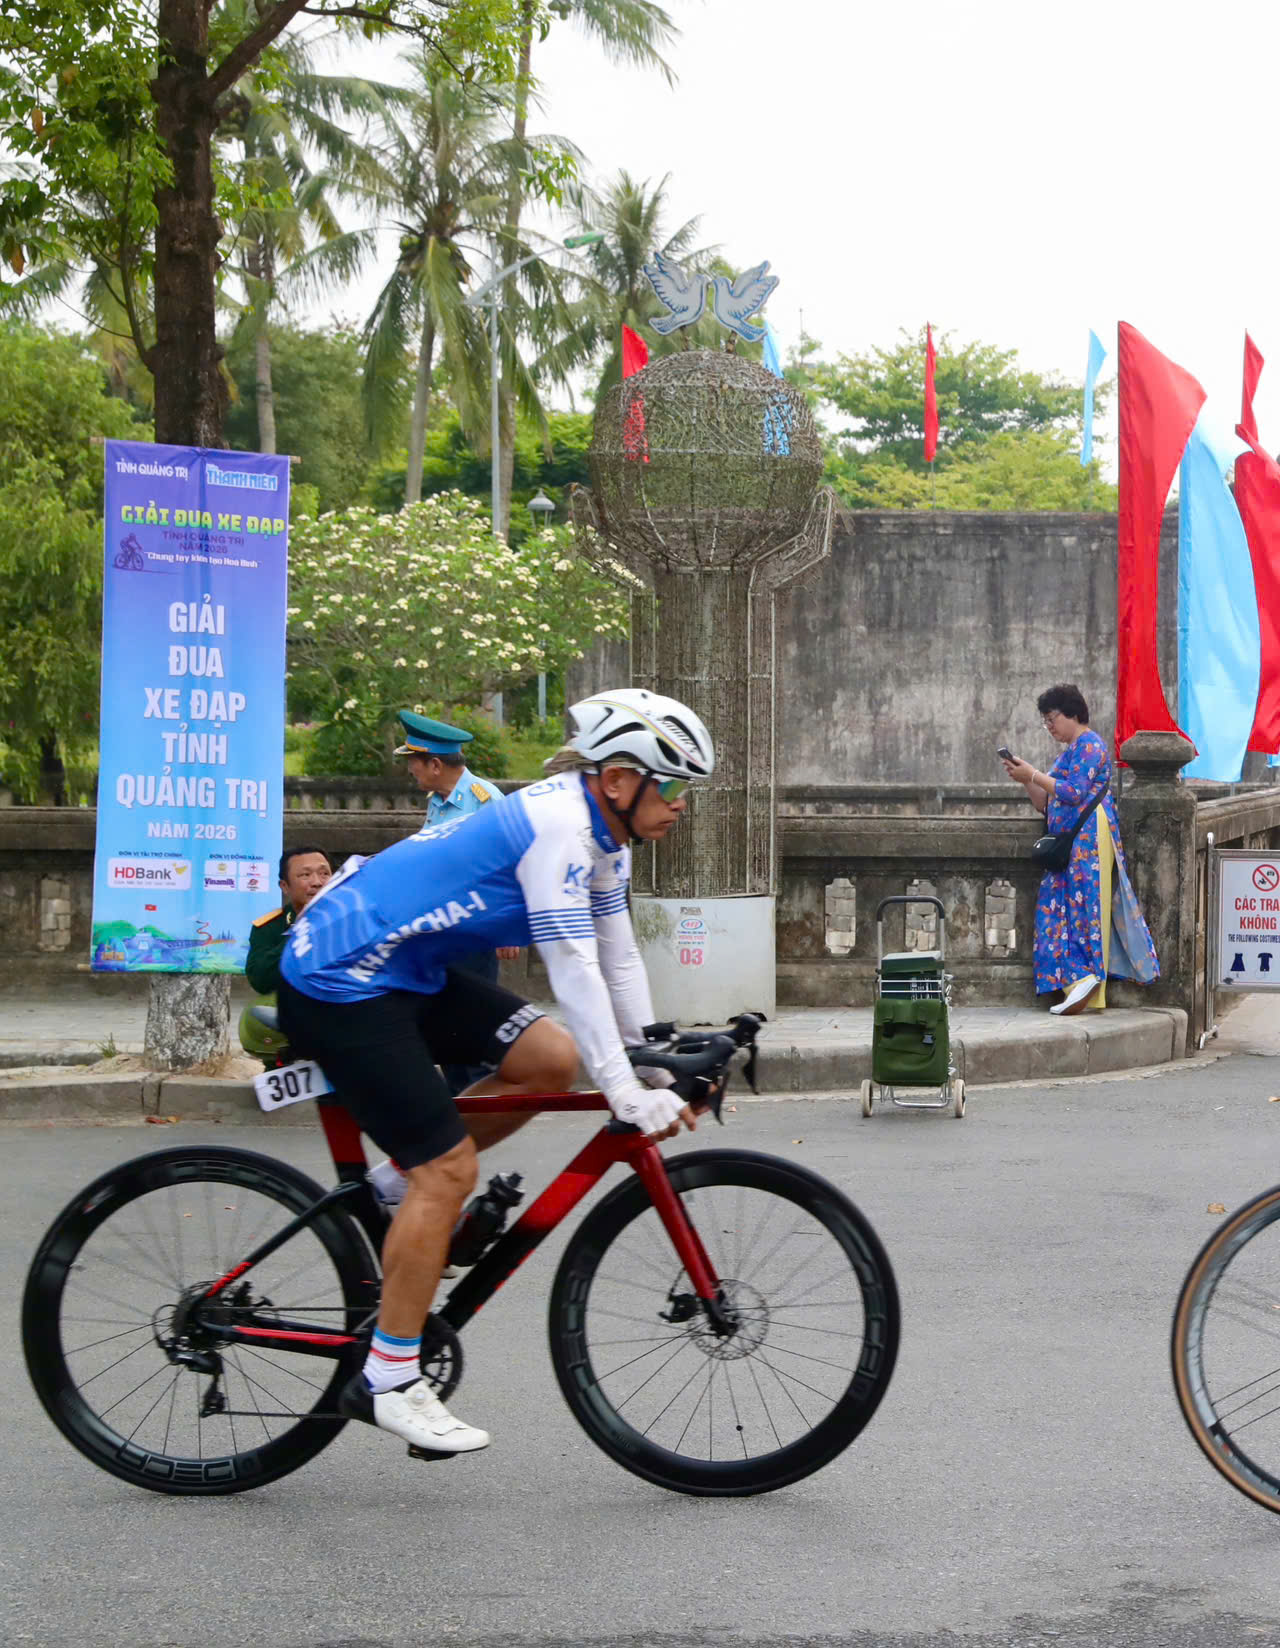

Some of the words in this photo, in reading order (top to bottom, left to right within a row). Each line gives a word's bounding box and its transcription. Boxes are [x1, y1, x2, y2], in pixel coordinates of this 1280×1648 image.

[121, 500, 170, 526] GIẢI
[174, 509, 213, 530] ĐUA
[218, 513, 242, 533] XE
[246, 515, 286, 540] ĐẠP
[169, 593, 225, 636] GIẢI
[168, 645, 225, 678] ĐUA
[144, 686, 181, 720] XE
[190, 689, 246, 728] ĐẠP
[161, 723, 229, 765] TỈNH
[116, 765, 216, 809] QUẢNG
[225, 778, 268, 818] TRỊ
[147, 819, 189, 840] NĂM
[195, 823, 238, 841] 2026
[114, 867, 172, 881] HDBank
[204, 877, 235, 888] Vinamilk
[1234, 895, 1257, 911] CÁC
[1240, 914, 1277, 930] KHÔNG
[1236, 934, 1258, 943] FOLLOWING
[680, 948, 703, 966] 03
[267, 1066, 313, 1102] 307
